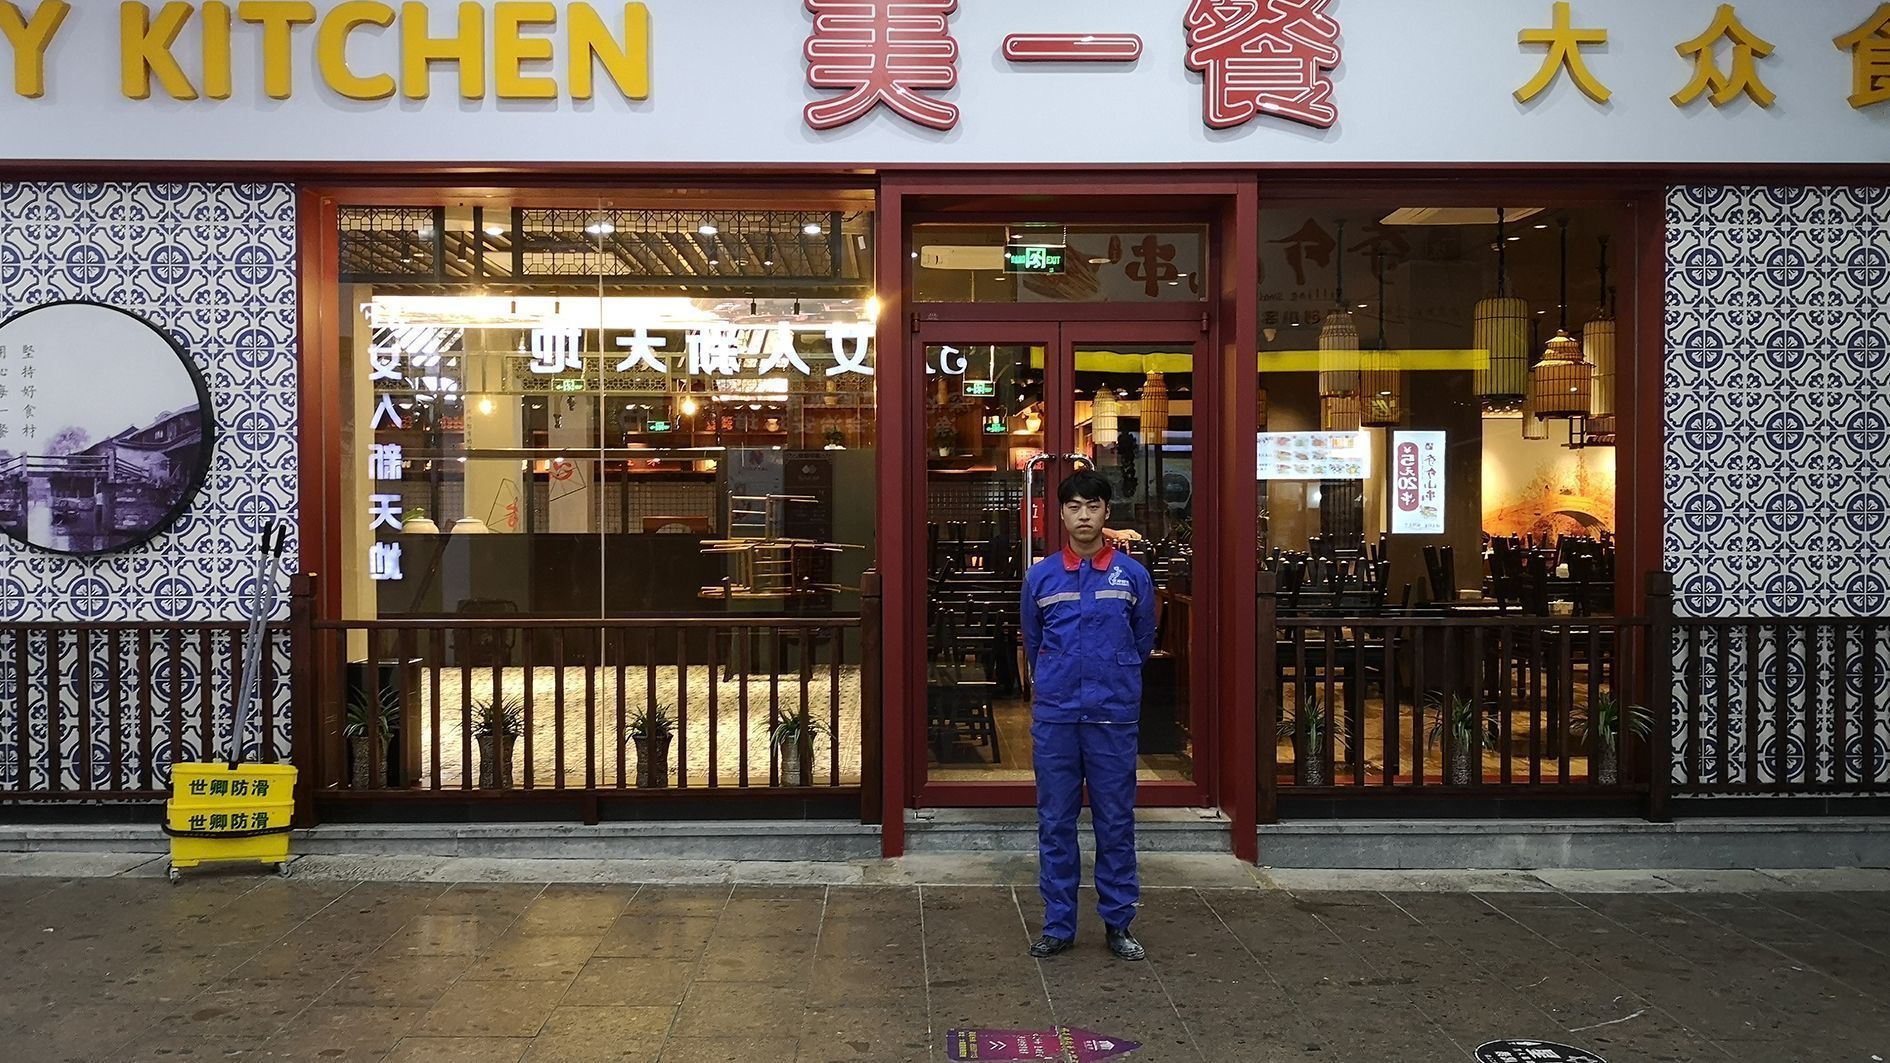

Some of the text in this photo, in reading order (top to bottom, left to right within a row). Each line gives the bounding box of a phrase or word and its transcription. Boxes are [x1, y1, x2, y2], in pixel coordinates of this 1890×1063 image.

[120, 0, 652, 100] KITCHEN
[803, 0, 1341, 130] 美一餐
[1046, 255, 1061, 265] EXIT
[188, 779, 269, 796] 世卿防滑
[188, 812, 269, 830] 世卿防滑
